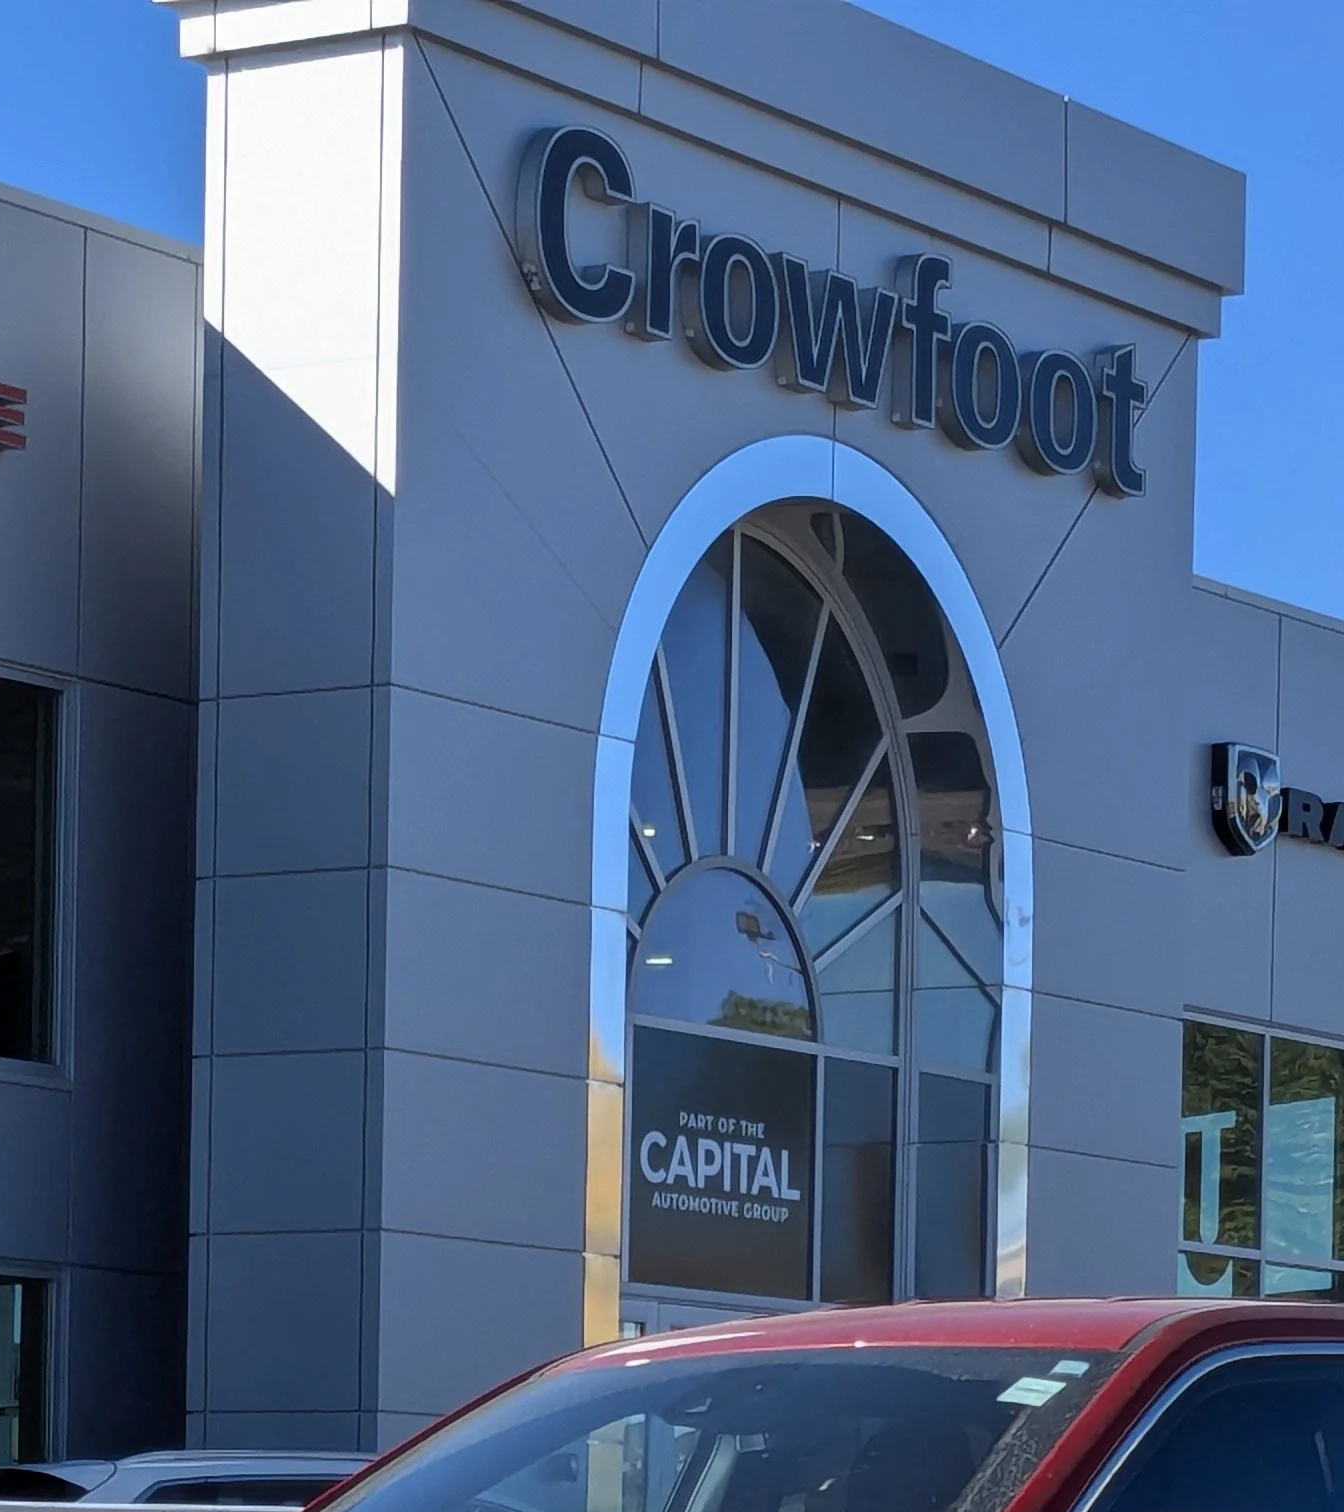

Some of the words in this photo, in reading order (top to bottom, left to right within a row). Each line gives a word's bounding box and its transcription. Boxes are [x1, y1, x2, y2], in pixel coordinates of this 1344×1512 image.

[516, 124, 1148, 498] Crowfoot
[679, 1111, 714, 1133] PART
[717, 1116, 736, 1135] OF
[740, 1120, 765, 1139] THE
[639, 1130, 801, 1201] CAPITAL
[652, 1190, 739, 1218] AUTOMOTIVE
[743, 1203, 789, 1224] GROUP
